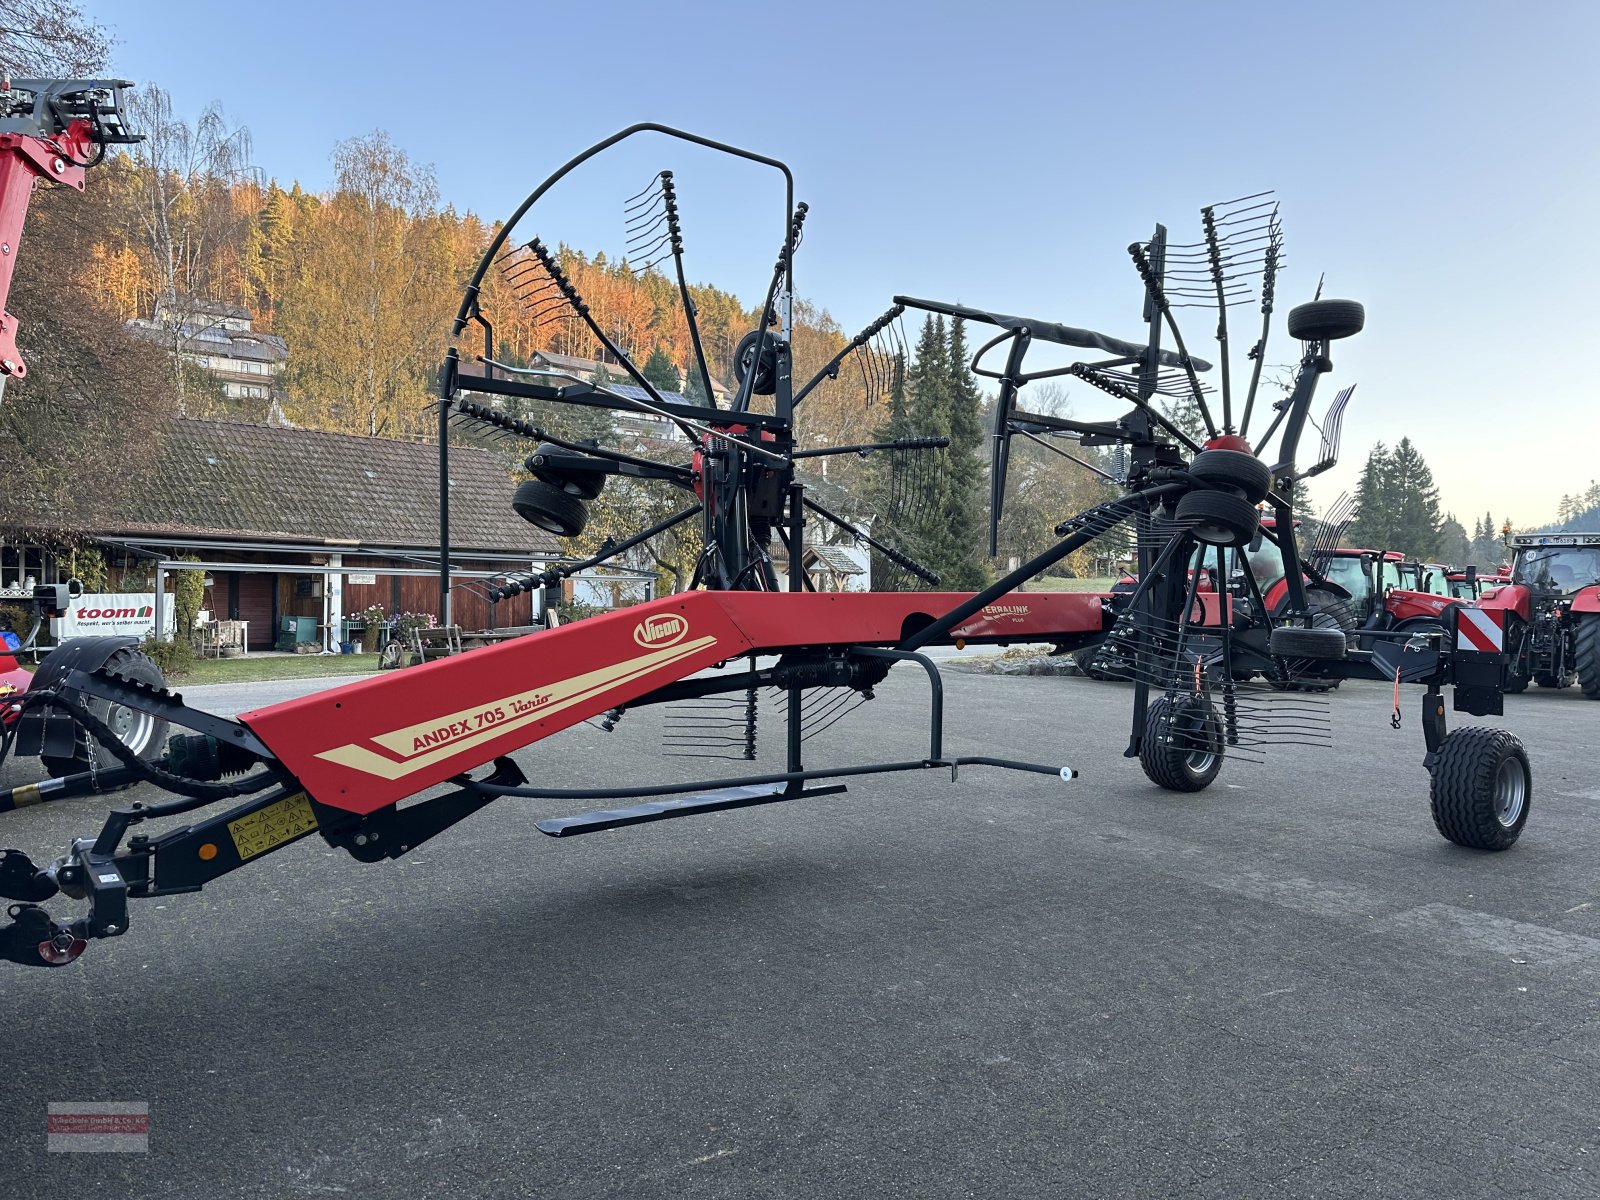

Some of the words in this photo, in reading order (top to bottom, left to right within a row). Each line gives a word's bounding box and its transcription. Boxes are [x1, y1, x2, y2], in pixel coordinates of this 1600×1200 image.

[77, 607, 136, 619] toom
[638, 618, 682, 643] Vicon
[414, 719, 473, 751] ANDEX
[474, 707, 505, 728] 705
[509, 693, 553, 713] Vario
